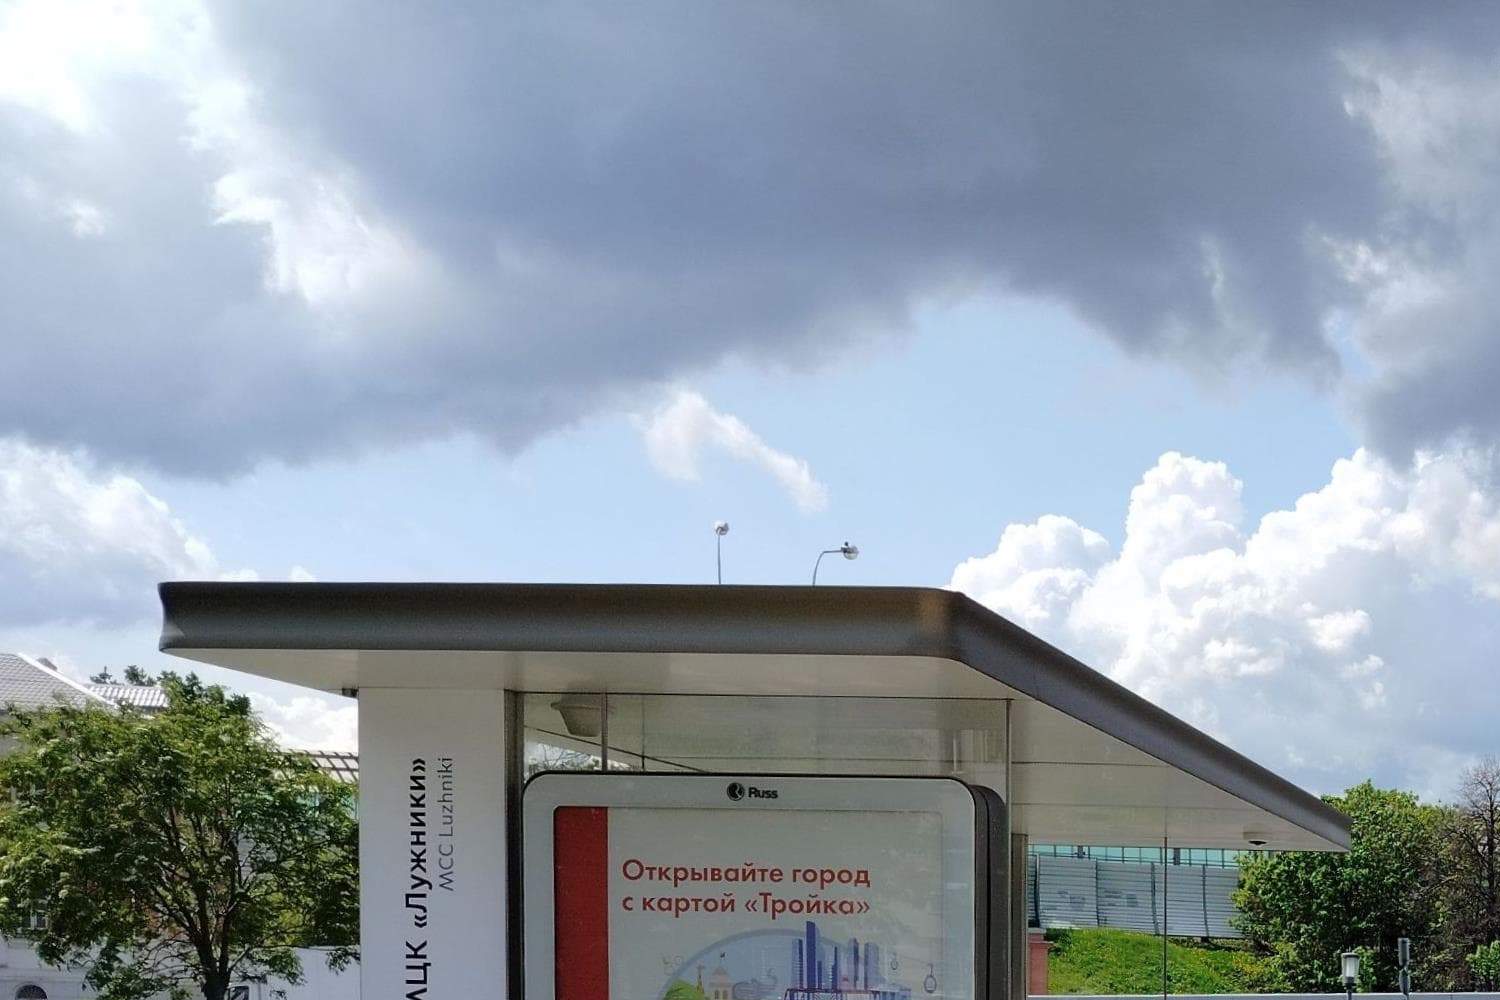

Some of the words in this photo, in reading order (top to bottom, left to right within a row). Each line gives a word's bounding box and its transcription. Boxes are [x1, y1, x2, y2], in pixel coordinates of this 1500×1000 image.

[437, 758, 454, 837] Luzhniki
[748, 787, 778, 799] Russ
[405, 758, 432, 928] «Лужники»
[438, 844, 454, 891] MCC
[622, 859, 783, 887] Открывайте
[792, 867, 871, 889] город
[622, 896, 633, 911] с
[642, 893, 736, 918] картой
[744, 892, 871, 920] «Тройка»
